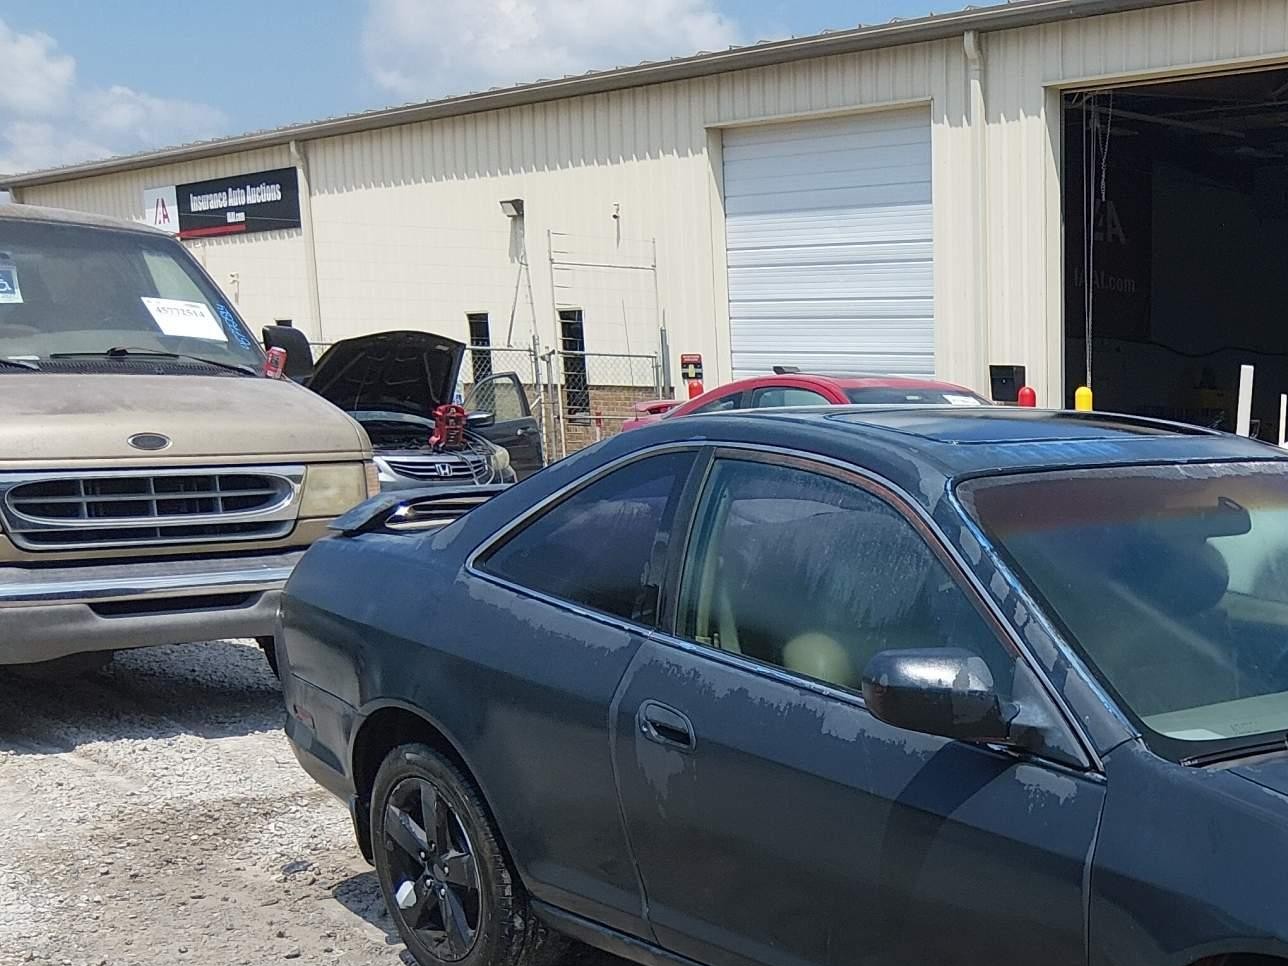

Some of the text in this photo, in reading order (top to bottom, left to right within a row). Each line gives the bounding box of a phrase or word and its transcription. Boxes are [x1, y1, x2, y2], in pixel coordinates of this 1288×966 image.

[189, 182, 282, 213] Insurance Auto Auctions
